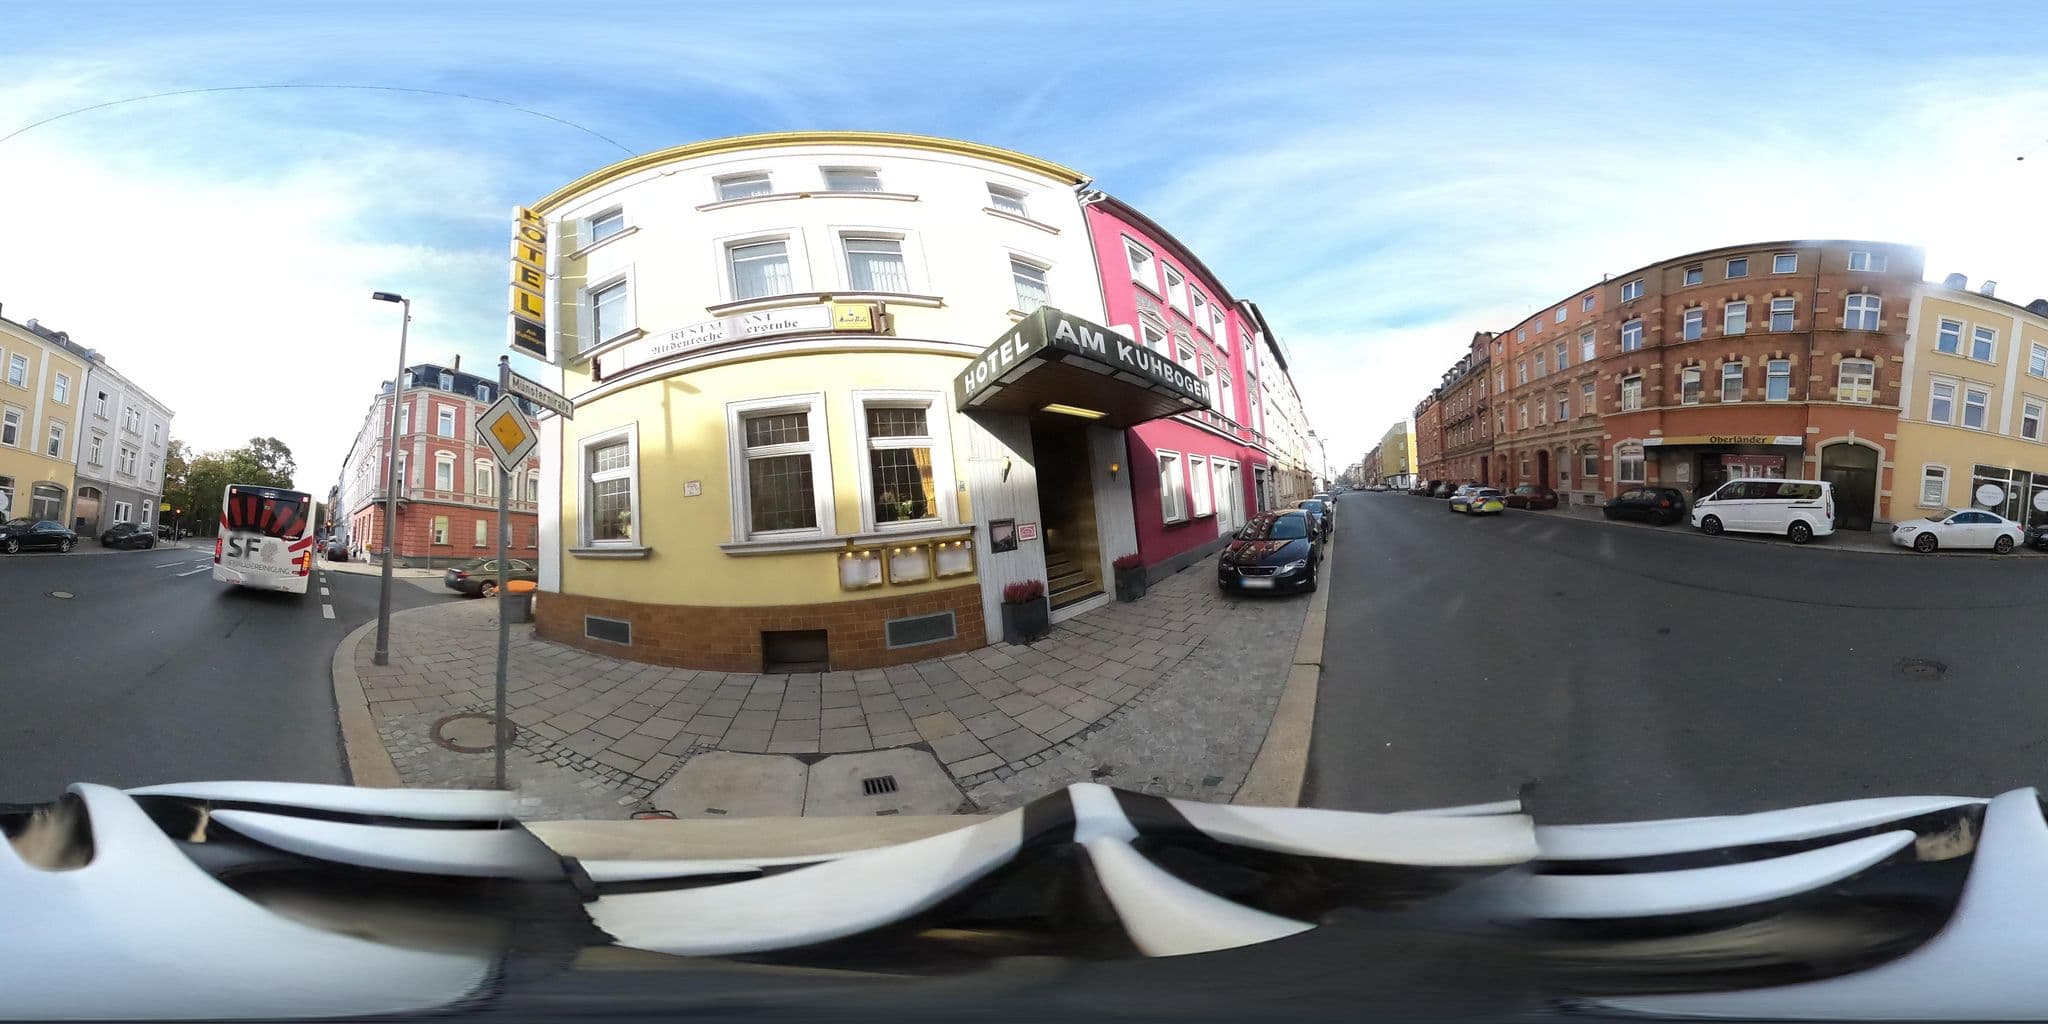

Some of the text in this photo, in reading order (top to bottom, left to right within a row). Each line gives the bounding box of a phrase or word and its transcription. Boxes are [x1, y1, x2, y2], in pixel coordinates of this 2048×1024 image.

[520, 209, 546, 318] HOTEL
[670, 312, 773, 341] RESTAUANT
[963, 331, 1030, 395] HOTEL
[1055, 319, 1209, 401] AM KUHBOGEN
[512, 376, 569, 414] Münsterraße
[1709, 435, 1768, 445] Oberländer
[227, 536, 261, 558] SF
